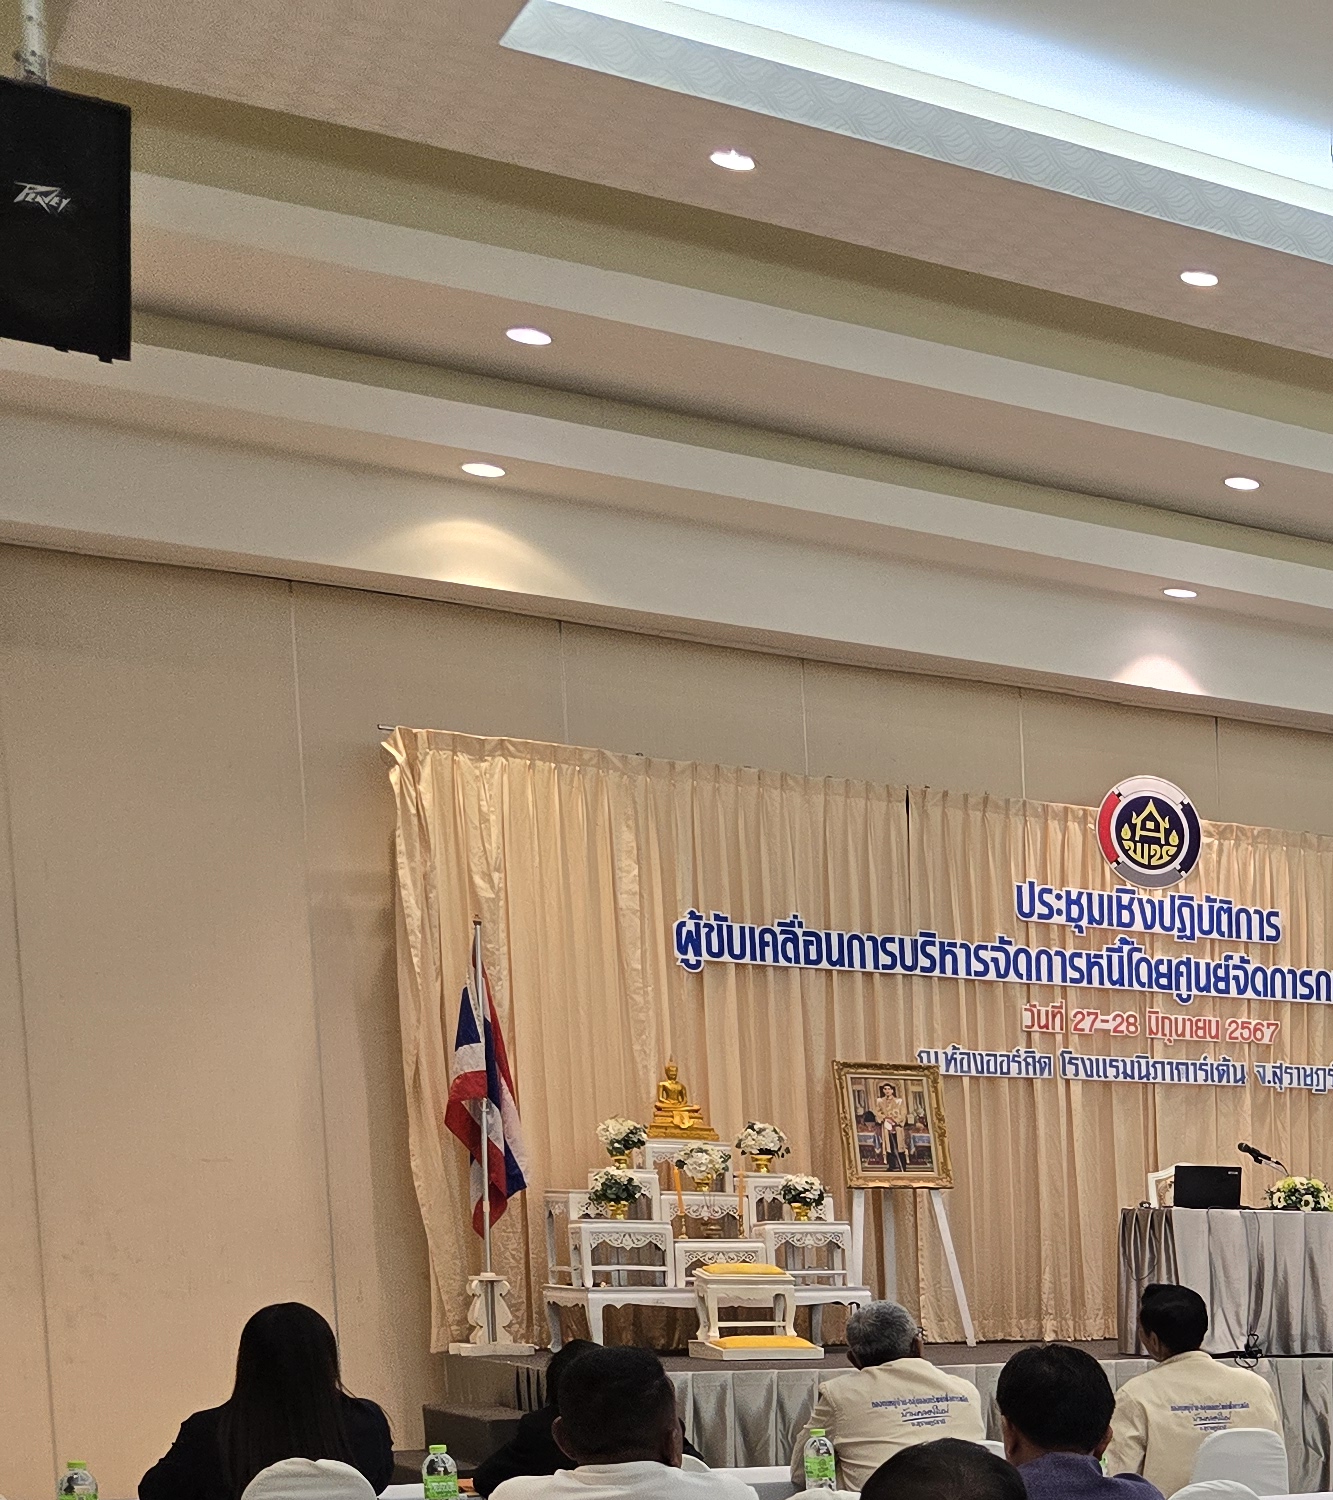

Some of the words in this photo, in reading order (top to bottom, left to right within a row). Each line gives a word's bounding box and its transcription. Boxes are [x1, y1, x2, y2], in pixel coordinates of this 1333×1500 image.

[1015, 880, 1282, 942] ประชุมเชิงปฏิบัติการ
[1023, 1001, 1064, 1033] วันที่
[1072, 1010, 1139, 1036] 27-28
[1147, 1010, 1221, 1044] มิถุนายน
[1225, 1019, 1281, 1044] 2567
